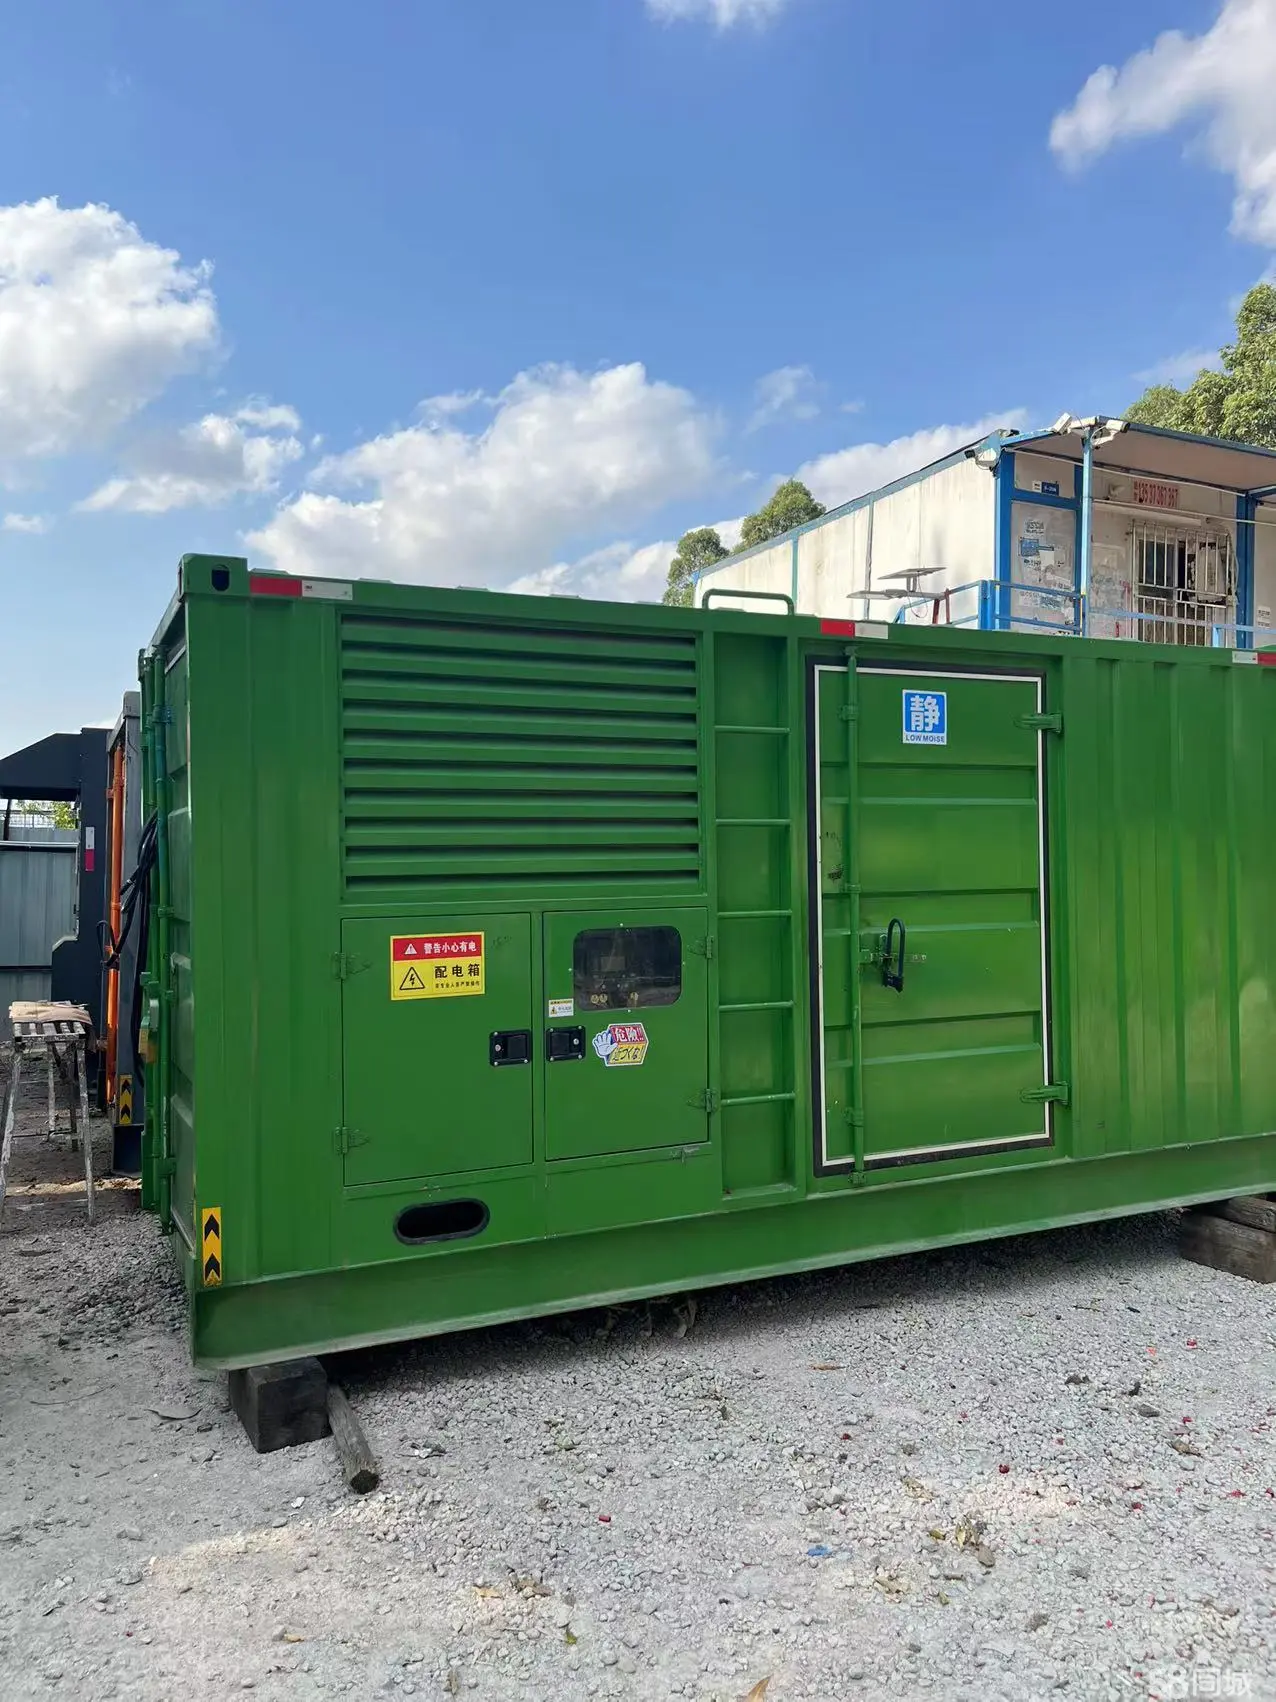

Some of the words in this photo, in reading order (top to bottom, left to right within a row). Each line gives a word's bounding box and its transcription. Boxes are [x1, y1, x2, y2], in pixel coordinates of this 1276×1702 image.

[910, 695, 940, 731] 静
[905, 734, 922, 742] LOW
[423, 941, 477, 954] 警告小心有电
[434, 964, 480, 979] 配电箱
